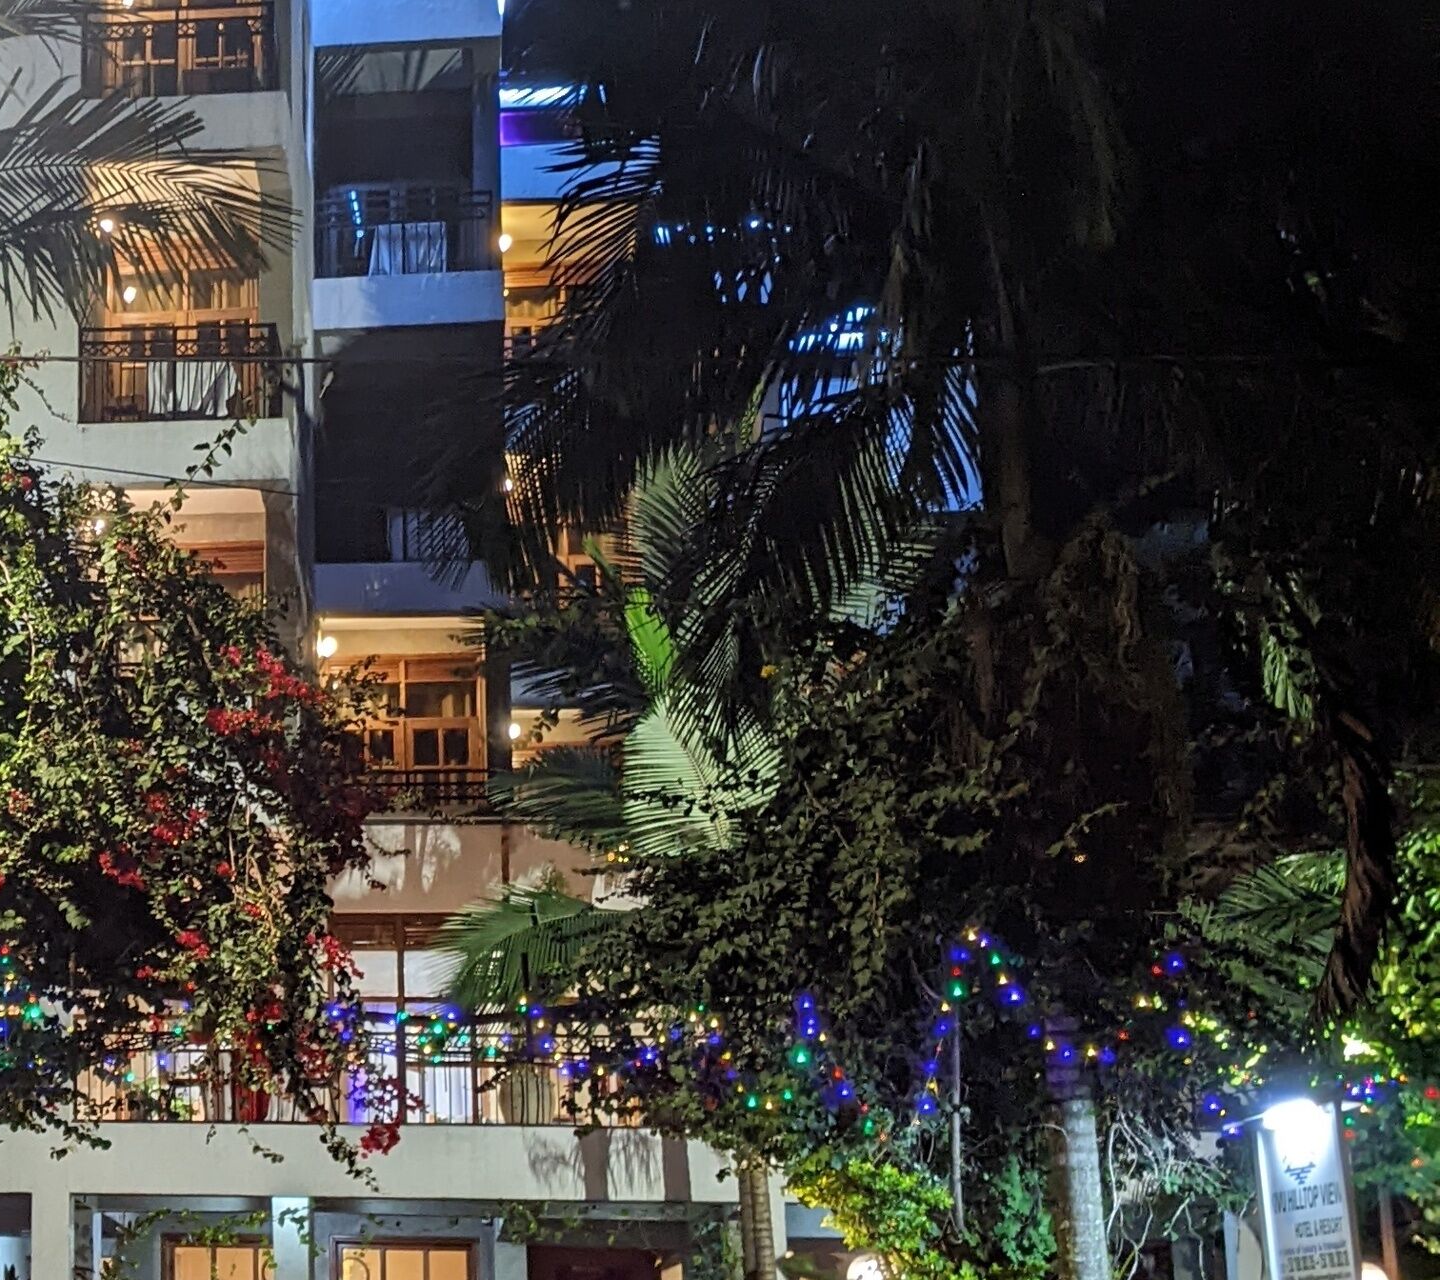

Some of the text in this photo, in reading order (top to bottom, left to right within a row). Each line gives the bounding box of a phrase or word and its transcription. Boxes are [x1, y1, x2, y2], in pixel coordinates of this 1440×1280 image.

[1287, 1185, 1319, 1213] HILLTOP
[1295, 1221, 1314, 1238] HOTEL
[1319, 1217, 1343, 1235] RESORT
